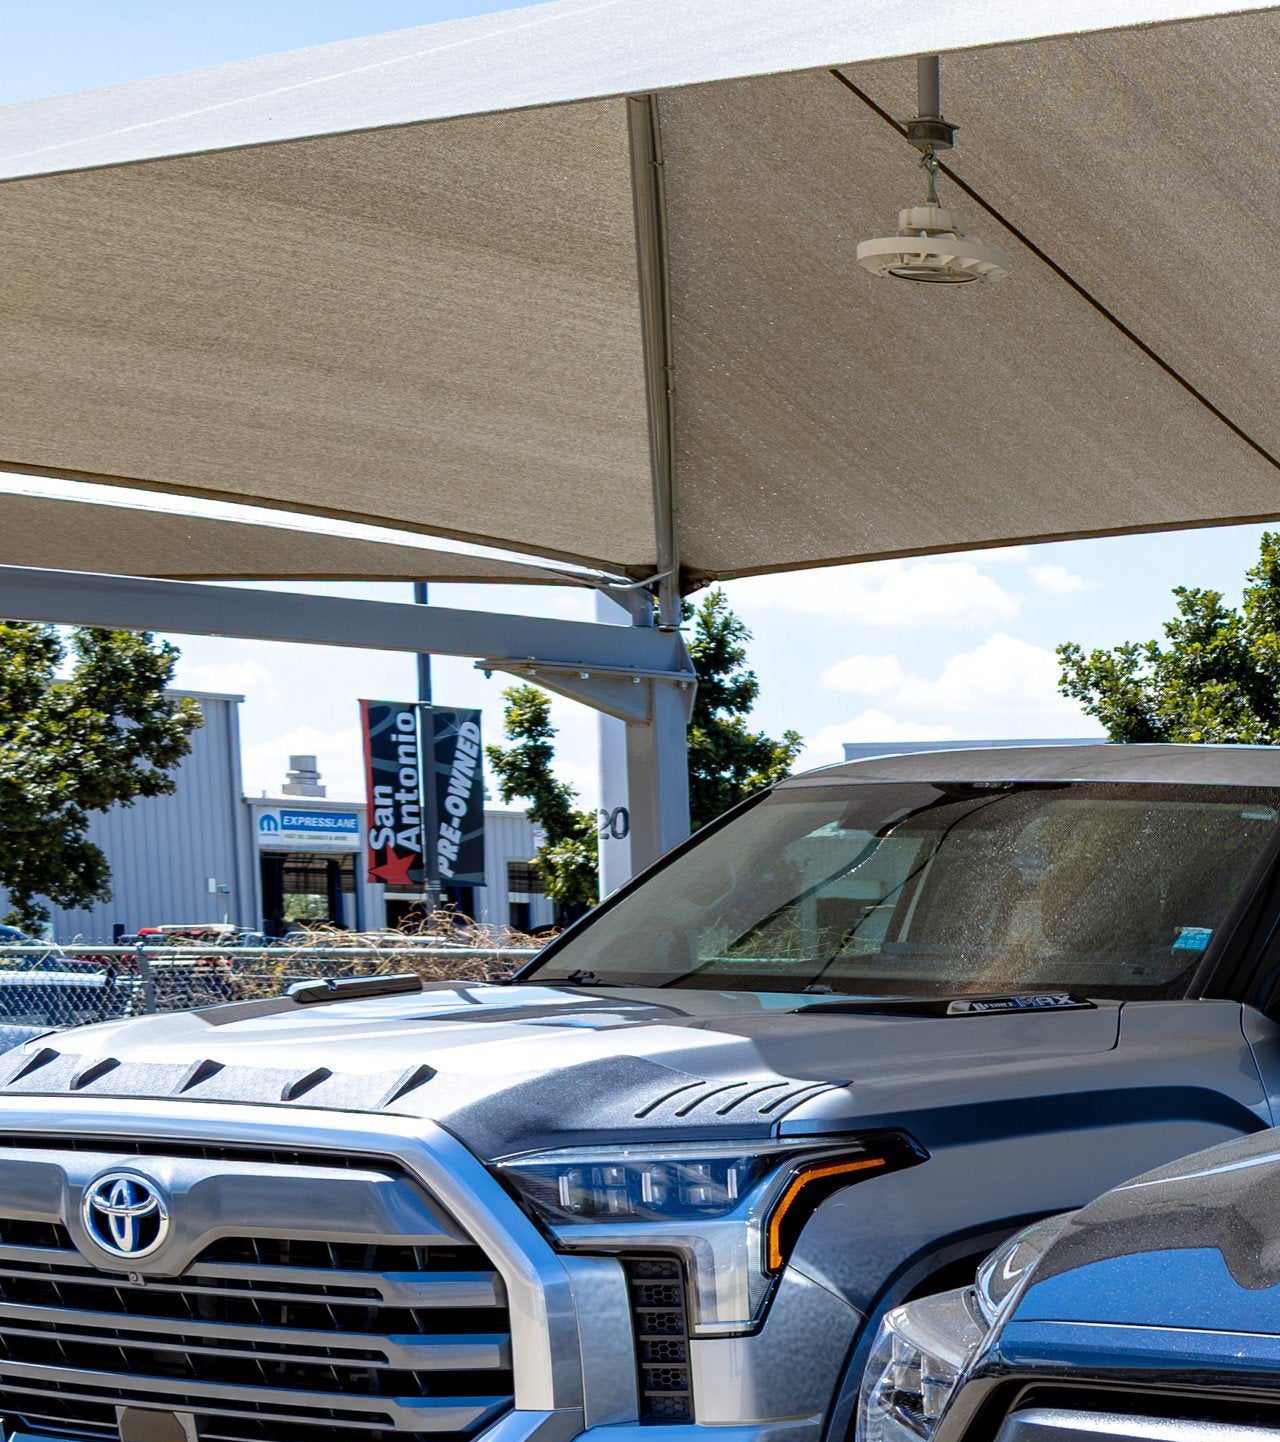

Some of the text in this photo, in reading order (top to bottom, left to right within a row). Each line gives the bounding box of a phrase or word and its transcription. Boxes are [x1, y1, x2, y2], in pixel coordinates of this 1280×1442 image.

[284, 815, 357, 829] EXPRESSLANE
[369, 785, 395, 850] San
[391, 712, 422, 853] Antonio
[437, 721, 480, 878] PRE-OWNED
